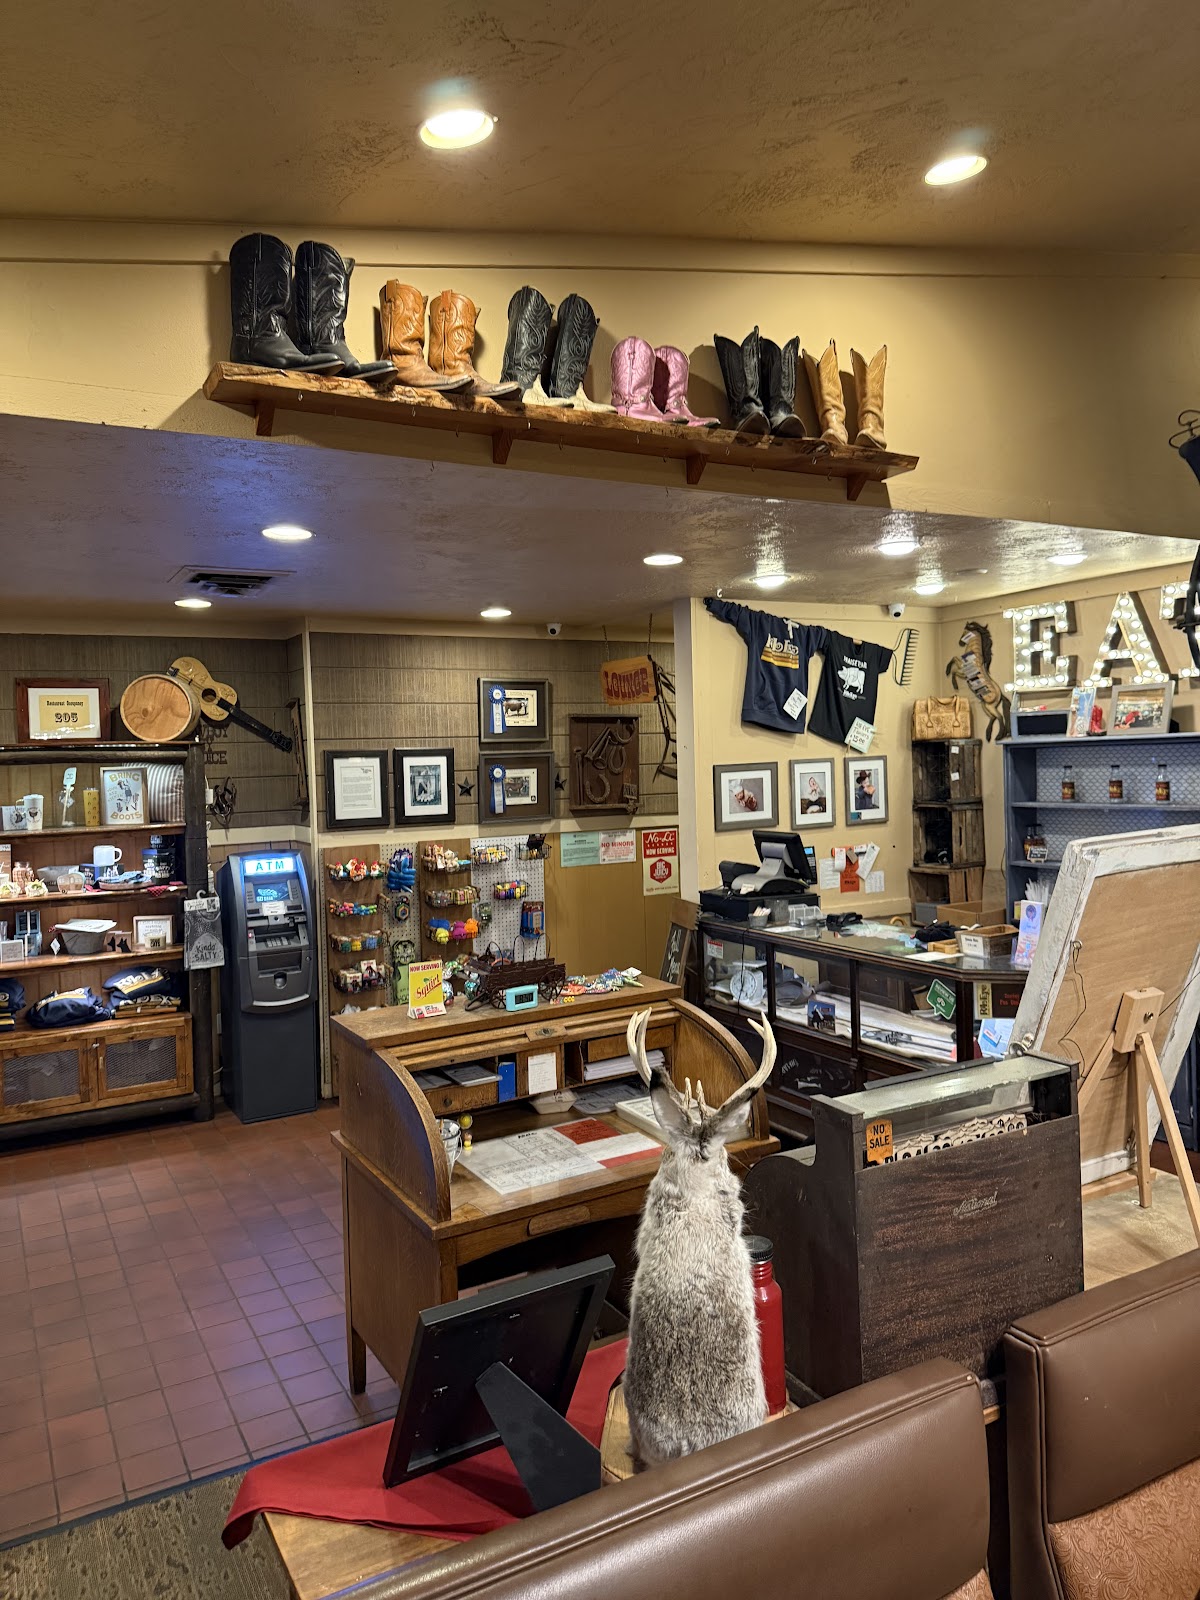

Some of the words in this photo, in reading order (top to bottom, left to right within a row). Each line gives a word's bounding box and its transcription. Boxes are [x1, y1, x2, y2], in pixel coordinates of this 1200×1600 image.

[603, 668, 649, 698] LOUNGE
[54, 712, 78, 723] 205
[109, 771, 140, 782] BRING
[110, 811, 142, 820] BOOTS
[611, 840, 635, 848] MINORS
[256, 860, 284, 871] ATM
[195, 951, 217, 961] SALTY
[415, 973, 442, 999] Squirt
[873, 1124, 885, 1135] NO
[869, 1135, 890, 1149] SALE
[953, 1190, 998, 1216] National
